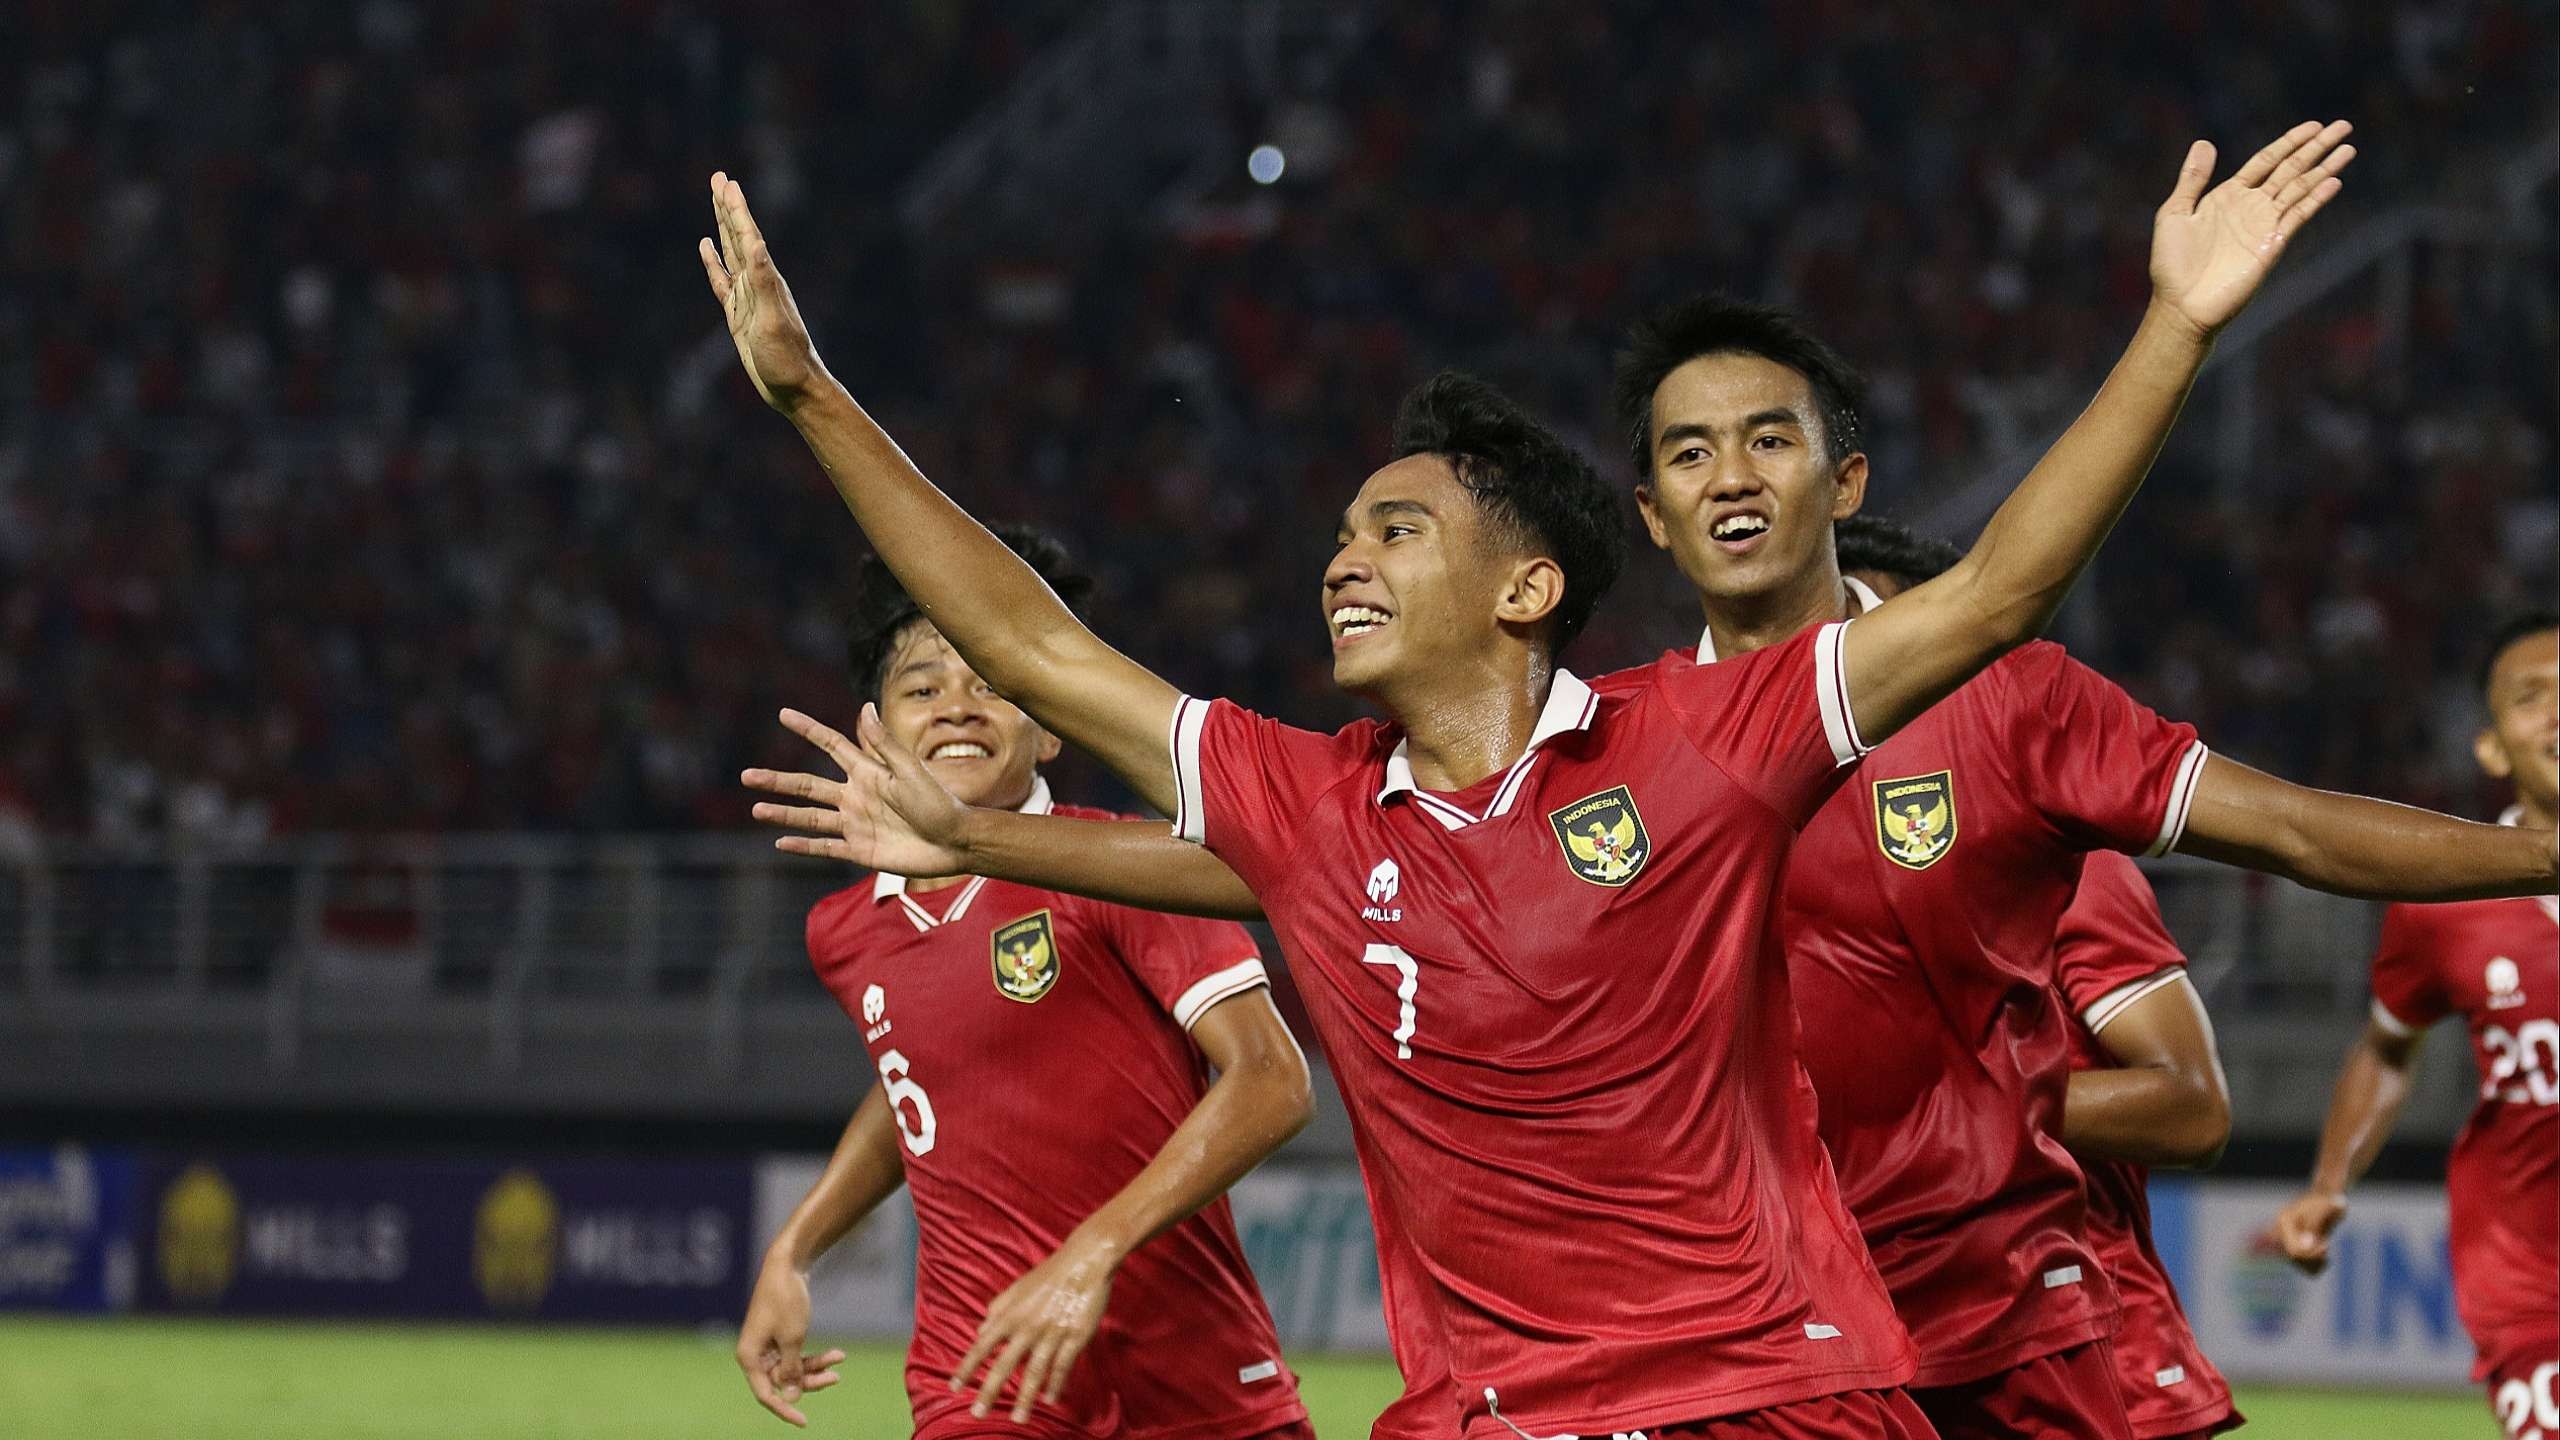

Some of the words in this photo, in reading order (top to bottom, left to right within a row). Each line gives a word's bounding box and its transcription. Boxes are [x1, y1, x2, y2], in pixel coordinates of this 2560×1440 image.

[1563, 797, 1621, 825] INDONESIA
[1361, 908, 1402, 922] MILLS
[1362, 943, 1419, 1059] 7
[2482, 1020, 2559, 1106] 20
[878, 1049, 937, 1157] 6
[246, 1207, 402, 1281] MILLS
[564, 1210, 732, 1287] MILLS
